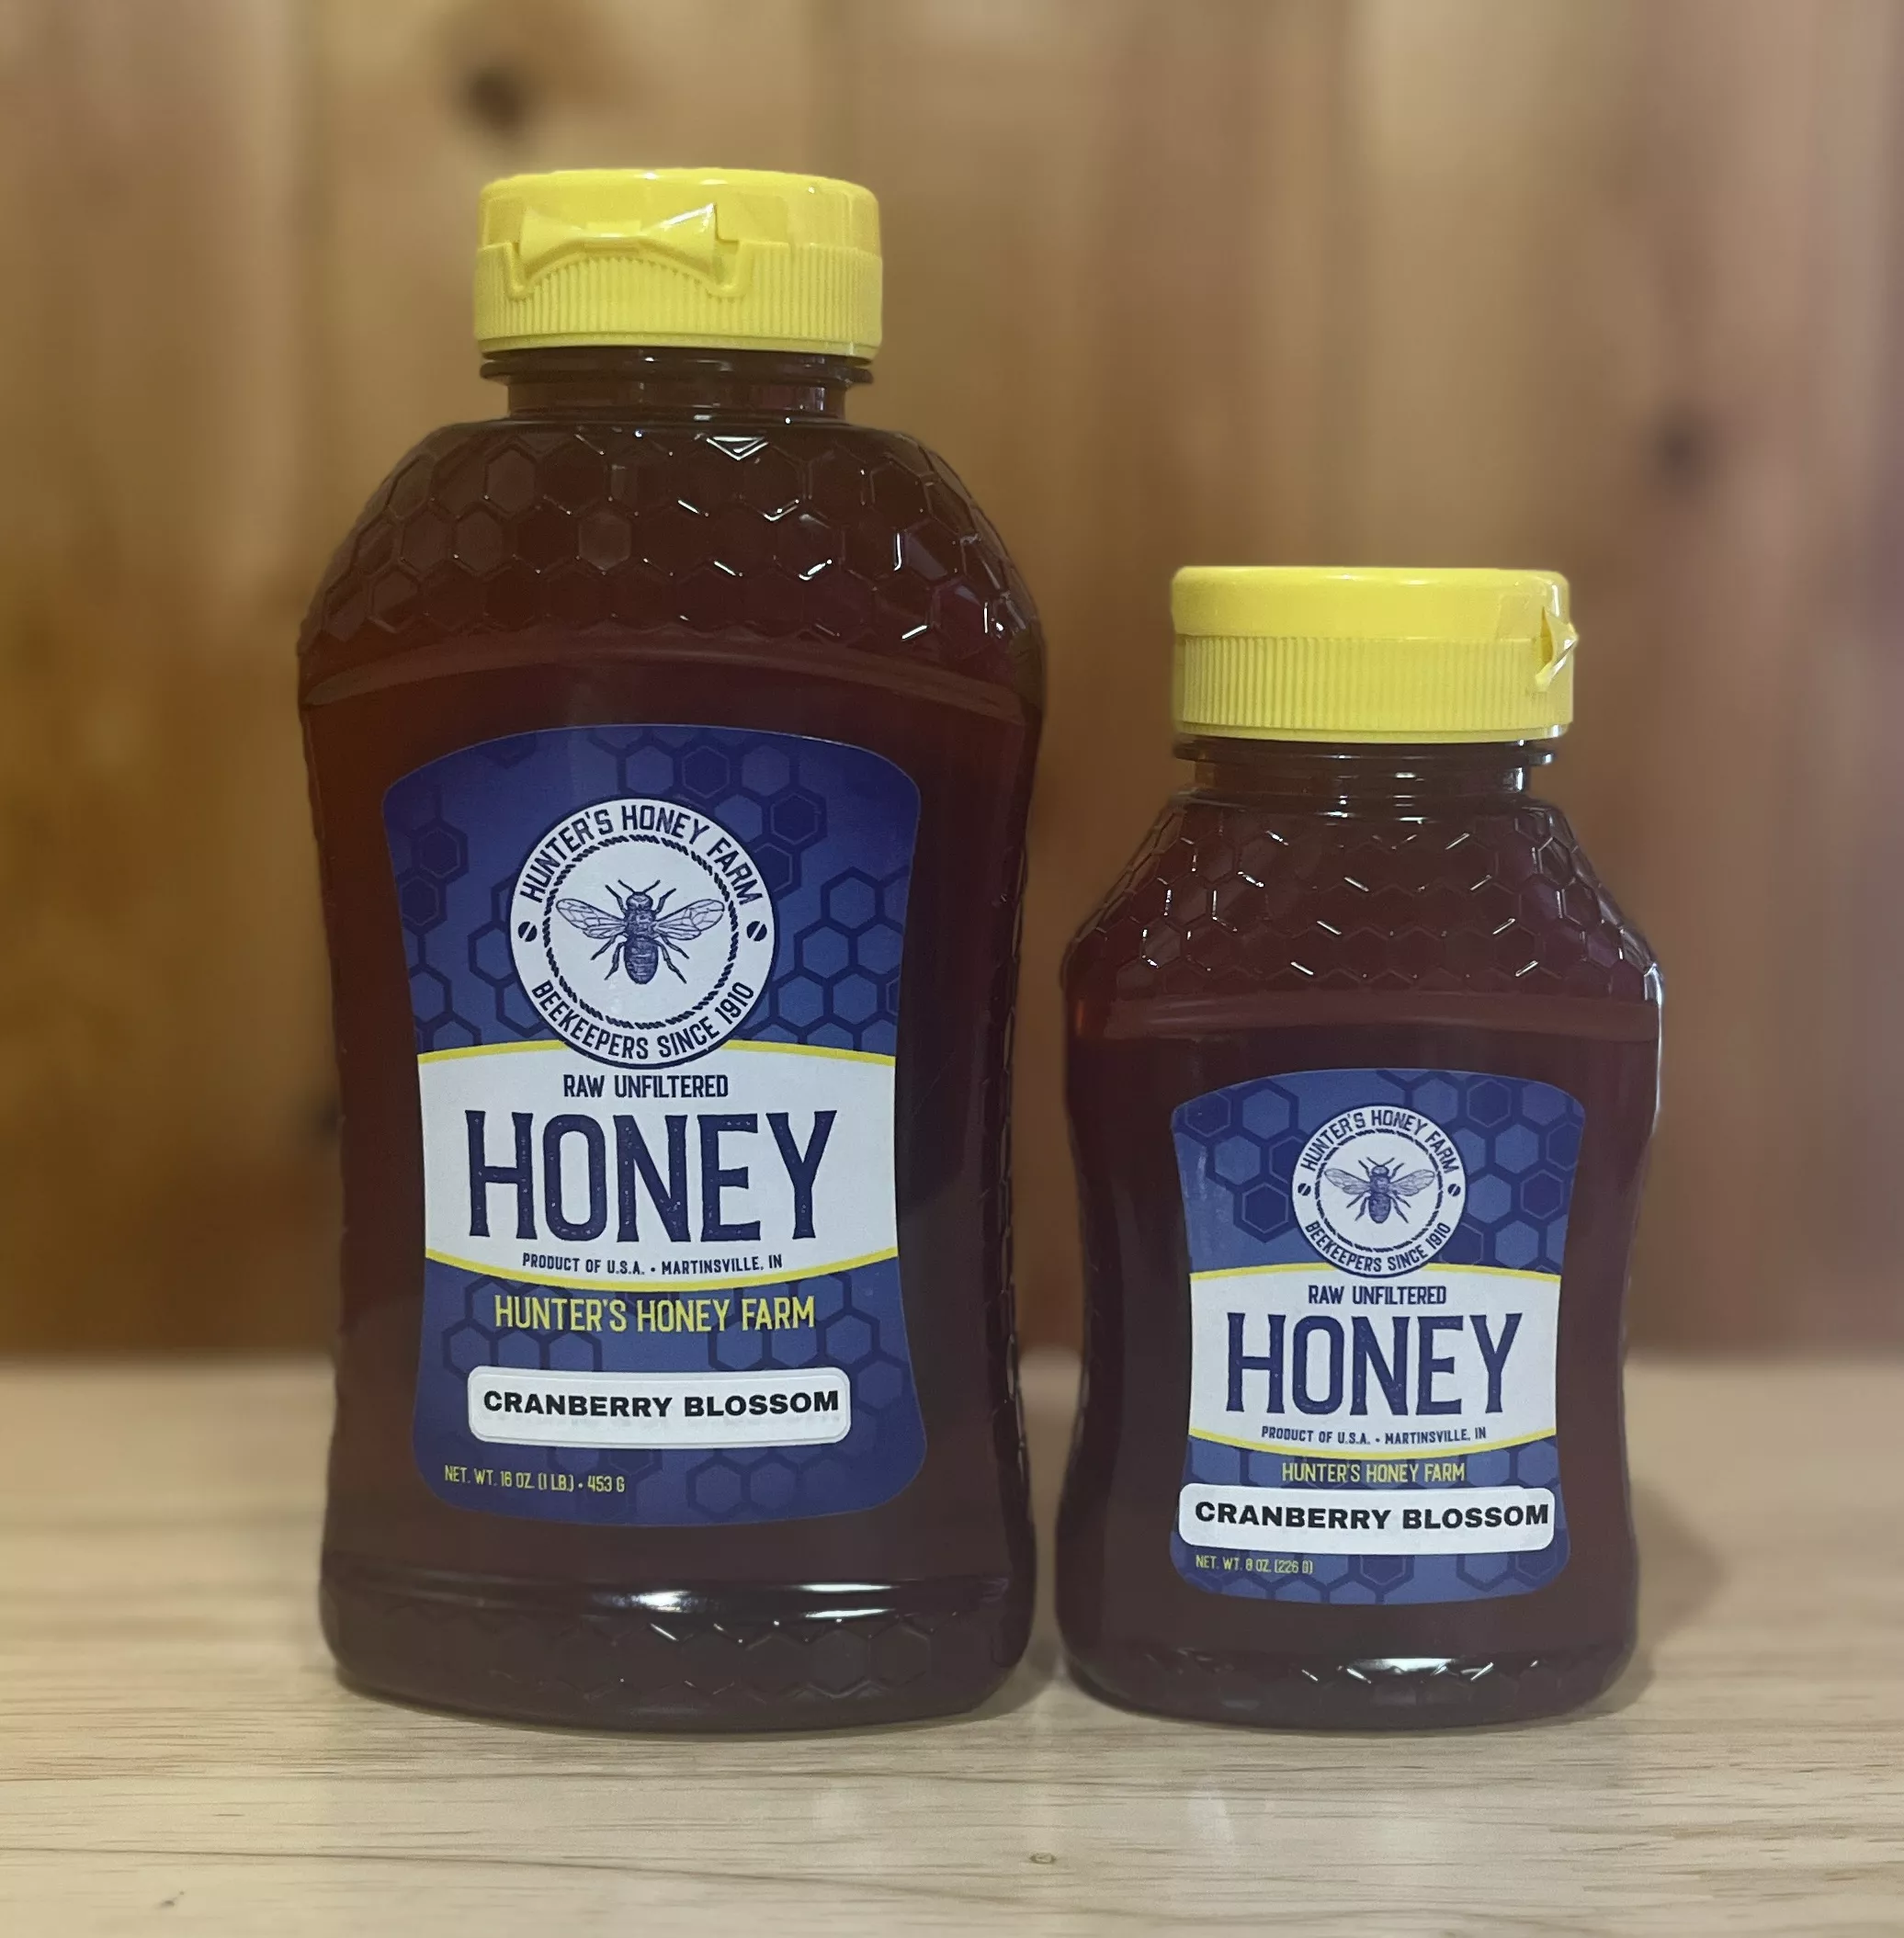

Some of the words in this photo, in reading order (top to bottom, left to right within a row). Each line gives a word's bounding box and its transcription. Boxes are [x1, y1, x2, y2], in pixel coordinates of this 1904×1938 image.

[520, 809, 614, 903] HUNTER'S
[621, 805, 710, 845] HONEY
[706, 837, 763, 906] FARM
[531, 979, 649, 1060] BEEKEEPERS
[657, 1016, 720, 1059] SINCE
[714, 981, 754, 1025] 1910
[563, 1074, 604, 1097] RAW
[615, 1074, 729, 1098] UNFILTERED
[1300, 1112, 1366, 1172] HUNTER'S
[1371, 1109, 1427, 1136] HONEY
[1424, 1131, 1460, 1174] FARM
[465, 1110, 837, 1242] HONEY
[1305, 1219, 1382, 1273] BEEKEEPERS
[1387, 1244, 1429, 1272] SINCE
[1424, 1222, 1451, 1251] 1910
[522, 1252, 580, 1273] PRODUCT
[585, 1259, 602, 1274] OF
[607, 1260, 645, 1275] U.S.A.
[768, 1253, 783, 1269] IN
[1308, 1286, 1345, 1305] RAW
[1352, 1286, 1447, 1305] UNFILTERED
[494, 1294, 627, 1332] HUNTER'S
[637, 1298, 731, 1332] HONEY
[741, 1295, 815, 1331] FARM
[1226, 1311, 1523, 1416] HONEY
[483, 1390, 673, 1418] CRANBERRY
[684, 1390, 840, 1417] BLOSSOM
[1261, 1425, 1314, 1444] PRODUCT
[1318, 1431, 1333, 1444] OF
[1337, 1432, 1371, 1445] U.S.A.
[1474, 1426, 1487, 1440] IN
[444, 1464, 471, 1484] NET.
[473, 1468, 498, 1487] WT.
[500, 1470, 512, 1488] 16
[587, 1475, 613, 1492] 453
[616, 1476, 626, 1492] G
[1281, 1462, 1361, 1483] HUNTER'S
[1366, 1463, 1420, 1484] HONEY
[1423, 1463, 1466, 1483] FARM
[1195, 1501, 1392, 1529] CRANBERRY
[1402, 1503, 1549, 1530] BLOSSOM
[1196, 1554, 1220, 1570] NET.
[1222, 1556, 1243, 1571] WT.
